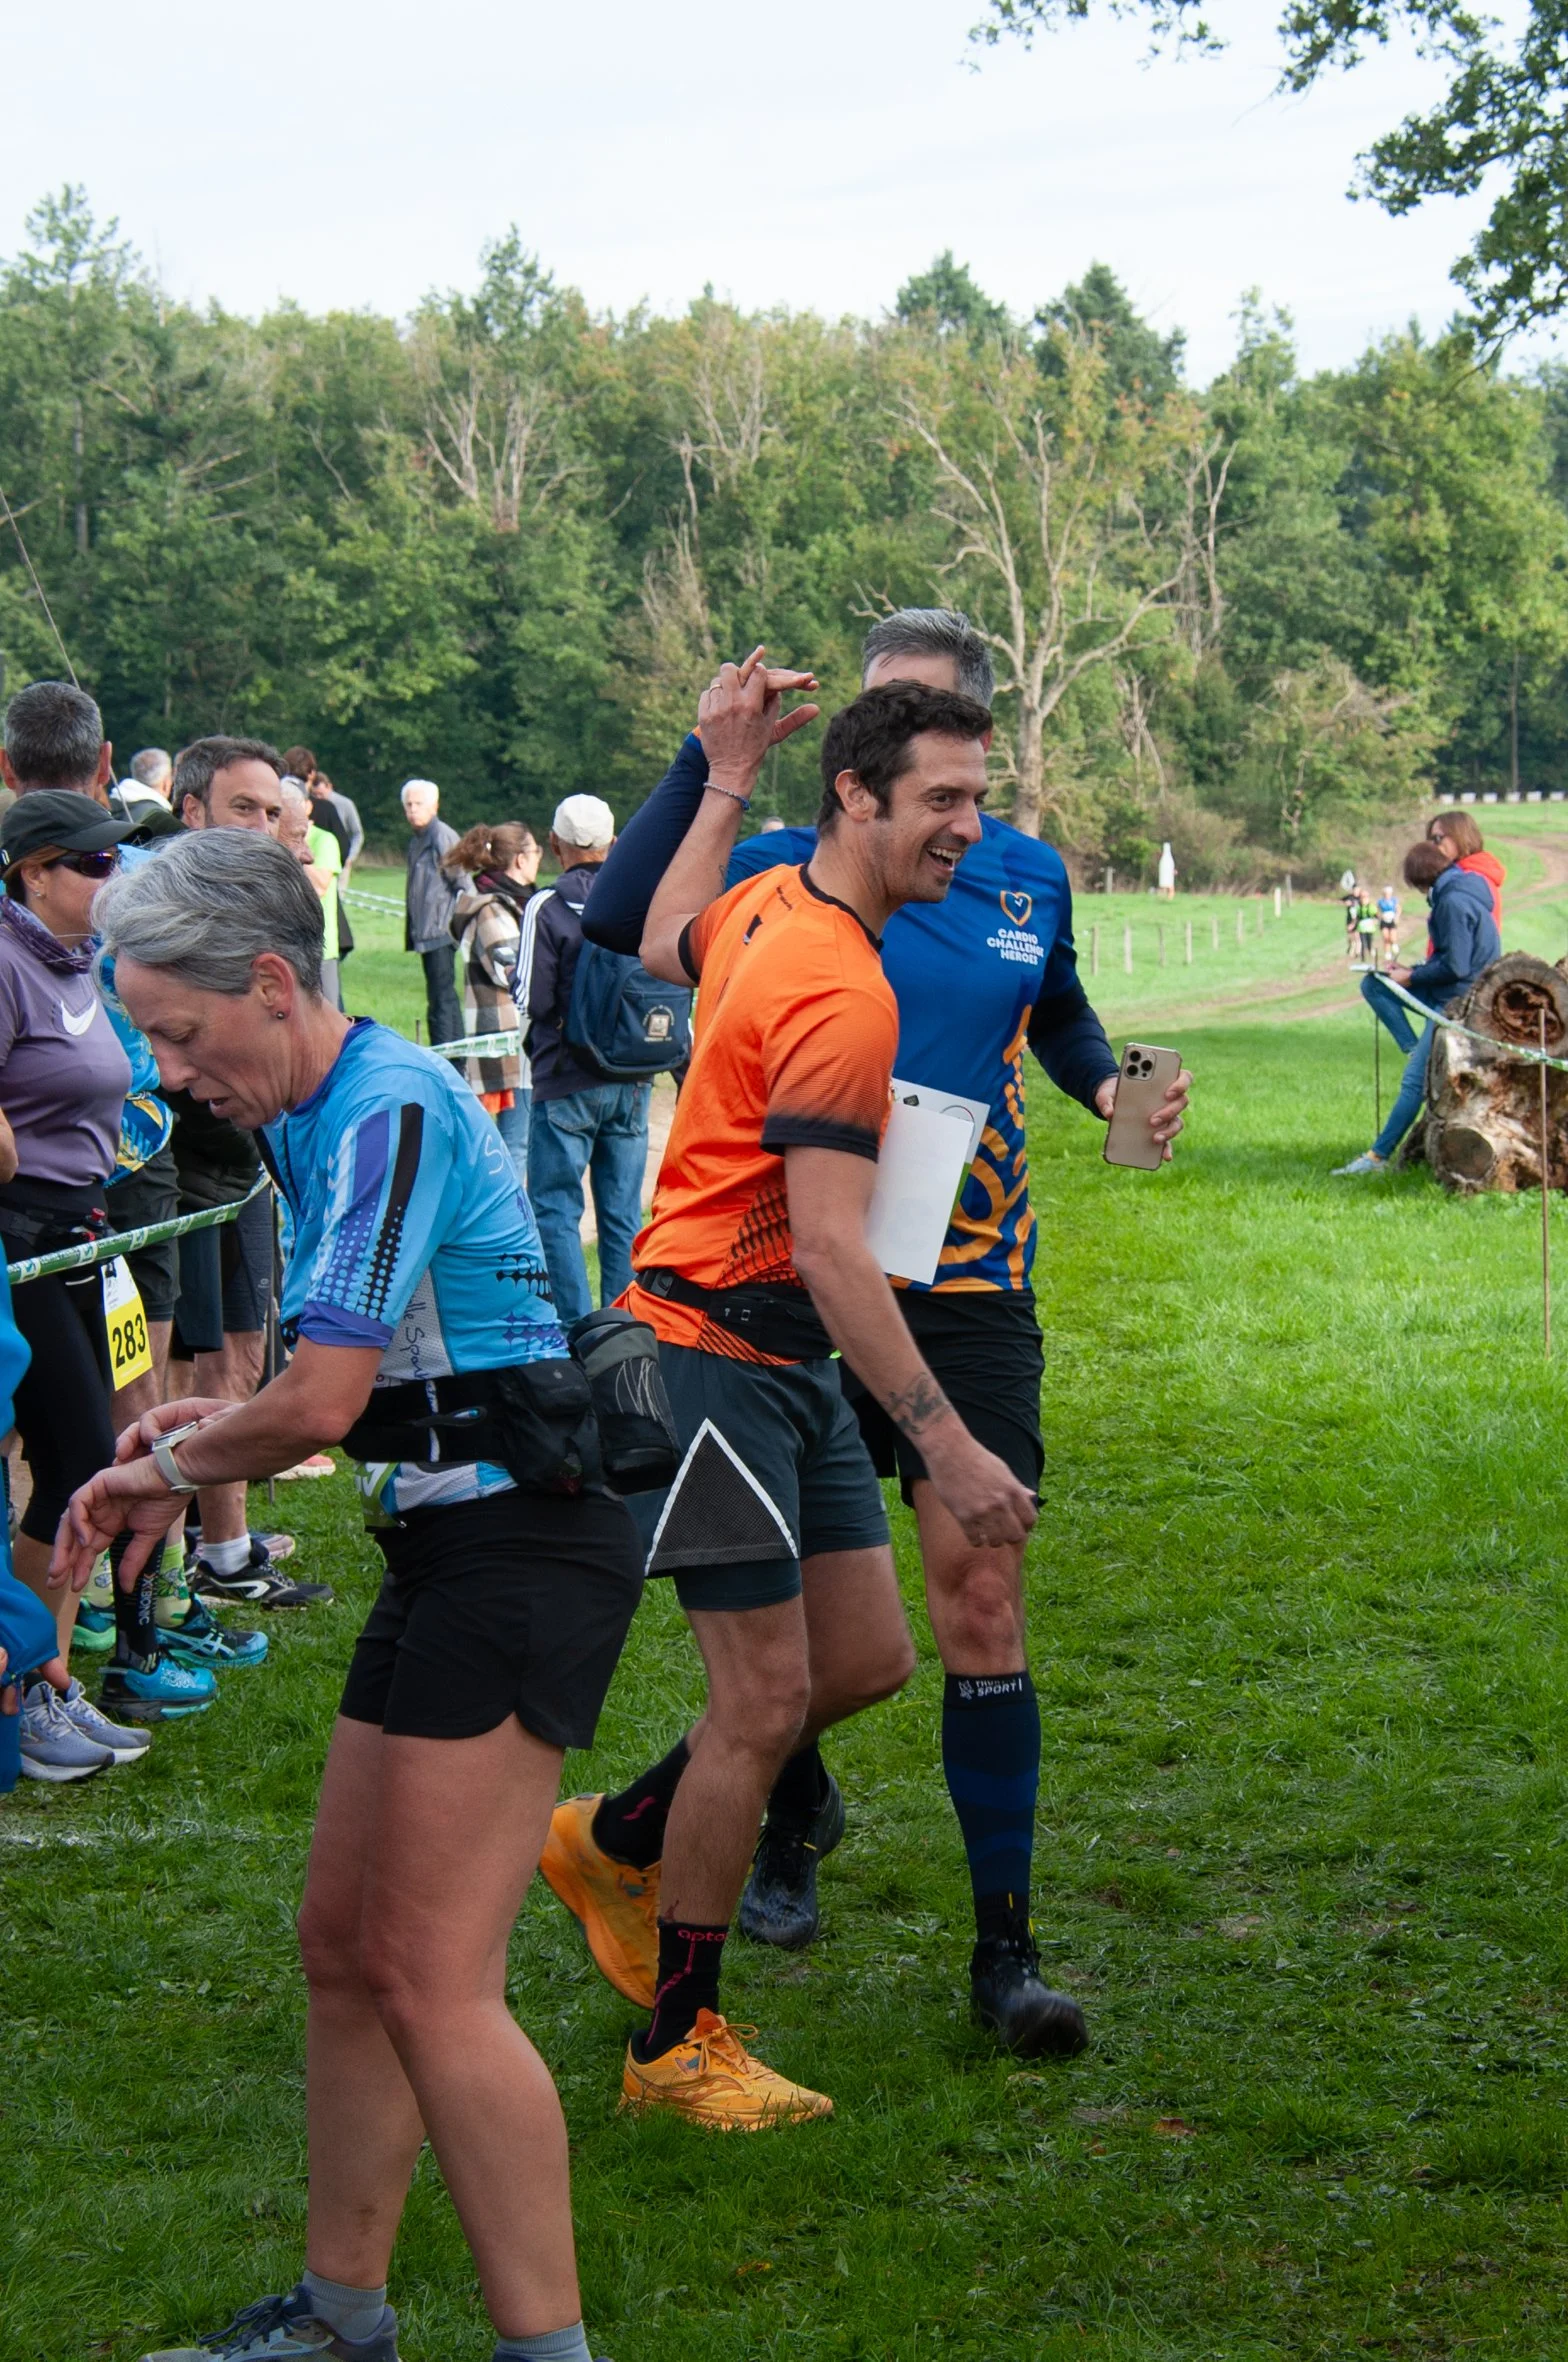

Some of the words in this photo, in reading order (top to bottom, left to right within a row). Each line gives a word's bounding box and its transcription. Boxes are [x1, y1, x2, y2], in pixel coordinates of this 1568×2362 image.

[997, 928, 1038, 944] CARDIO
[986, 936, 1044, 958] CHALLENGE
[1000, 949, 1038, 965] HEROES
[403, 1300, 427, 1320] lle
[112, 1313, 146, 1369] 283
[977, 1682, 1016, 1697] SPORT
